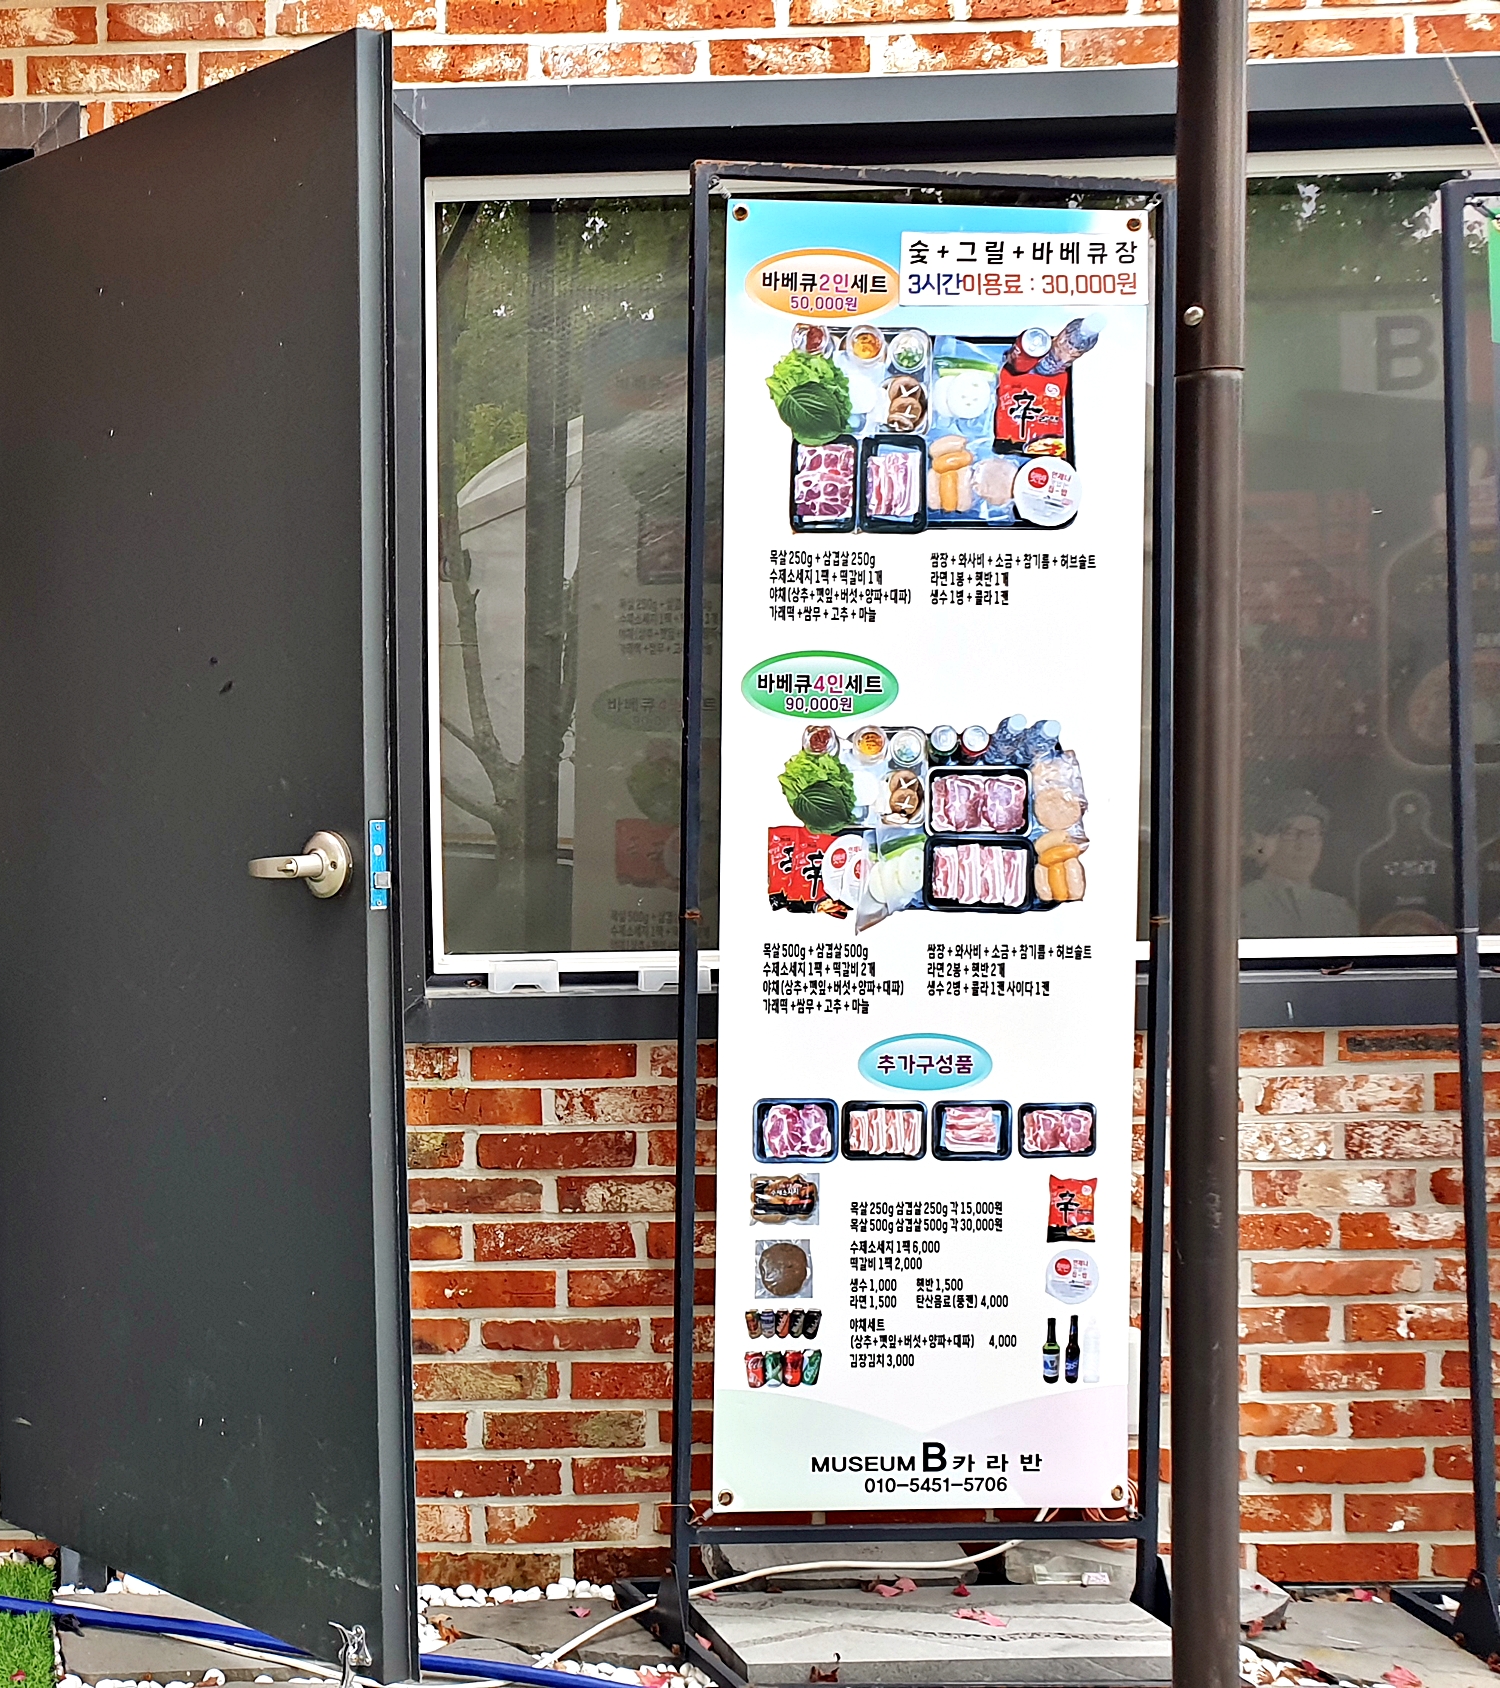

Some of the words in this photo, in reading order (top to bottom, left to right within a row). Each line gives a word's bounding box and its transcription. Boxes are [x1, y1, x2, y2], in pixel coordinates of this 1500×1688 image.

[761, 270, 889, 295] 바베큐2인세트
[907, 272, 1024, 297] 3시간이용료
[1041, 272, 1138, 297] 30,000원
[789, 295, 859, 314] 50,000원
[1375, 315, 1440, 392] B
[770, 550, 787, 565] 목살
[789, 551, 812, 568] 250g
[823, 551, 849, 566] 삼겹살
[851, 552, 875, 569] 250g
[930, 553, 948, 568] 쌈장
[958, 553, 984, 568] 와사비
[995, 554, 1013, 568] 소금
[1023, 554, 1050, 569] 참기름
[1061, 554, 1096, 569] 허브솔트
[840, 570, 865, 585] 떡갈비
[869, 570, 882, 585] 1개
[931, 571, 947, 586] 라면
[951, 572, 964, 587] 1봉
[975, 572, 992, 587] 햇반
[930, 589, 948, 605] 생수
[950, 590, 963, 605] 1병
[975, 590, 992, 605] 콜라
[769, 606, 794, 621] 가래떡
[831, 607, 848, 622] 고추
[859, 607, 876, 622] 마늘
[757, 673, 883, 695] 바베큐4인세트
[785, 697, 853, 713] 90,000원
[763, 943, 780, 958] 목살
[782, 944, 805, 960] 500g
[816, 943, 842, 959] 삼겹살
[844, 944, 868, 960] 500g
[927, 944, 945, 959] 쌈장
[955, 944, 981, 959] 와사비
[991, 944, 1009, 959] 소금
[1020, 944, 1045, 959] 참기름
[1057, 944, 1092, 960] 허브솔트
[833, 962, 858, 977] 떡갈비
[861, 962, 875, 977] 2개
[928, 962, 944, 977] 라면
[947, 963, 961, 977] 2봉
[972, 962, 989, 977] 햇반
[927, 981, 944, 996] 생수
[947, 981, 960, 996] 2병
[971, 981, 989, 996] 콜라
[1007, 981, 1033, 996] 사이다
[763, 998, 788, 1014] 가래떡
[824, 999, 841, 1014] 고추
[852, 998, 869, 1014] 마늘
[877, 1054, 974, 1075] 추가구성품
[850, 1202, 868, 1216] 목살
[870, 1202, 893, 1217] 250g
[896, 1201, 922, 1215] 삼겹살
[924, 1202, 947, 1217] 250g
[950, 1201, 958, 1215] 각
[961, 1201, 1002, 1216] 15,000원
[850, 1218, 868, 1232] 목살
[870, 1219, 893, 1234] 500g
[896, 1218, 922, 1232] 삼겹살
[924, 1219, 947, 1234] 500g
[950, 1218, 958, 1232] 각
[960, 1218, 1002, 1233] 30,000원
[913, 1241, 940, 1255] 6,000
[850, 1257, 876, 1271] 떡갈비
[895, 1257, 922, 1272] 2,000
[850, 1278, 867, 1292] 생수
[870, 1279, 897, 1293] 1,000
[917, 1278, 933, 1292] 햇반
[936, 1278, 963, 1293] 1,500
[850, 1295, 867, 1309] 라면
[870, 1295, 896, 1310] 1,500
[981, 1295, 1008, 1309] 4,000
[850, 1318, 885, 1332] 야채세트
[989, 1335, 1016, 1349] 4,000
[850, 1354, 884, 1368] 김장김치
[887, 1354, 914, 1368] 3,000
[811, 1456, 915, 1472] MUSEUM
[923, 1442, 947, 1472] B
[864, 1477, 1008, 1493] 010-5451-5706
